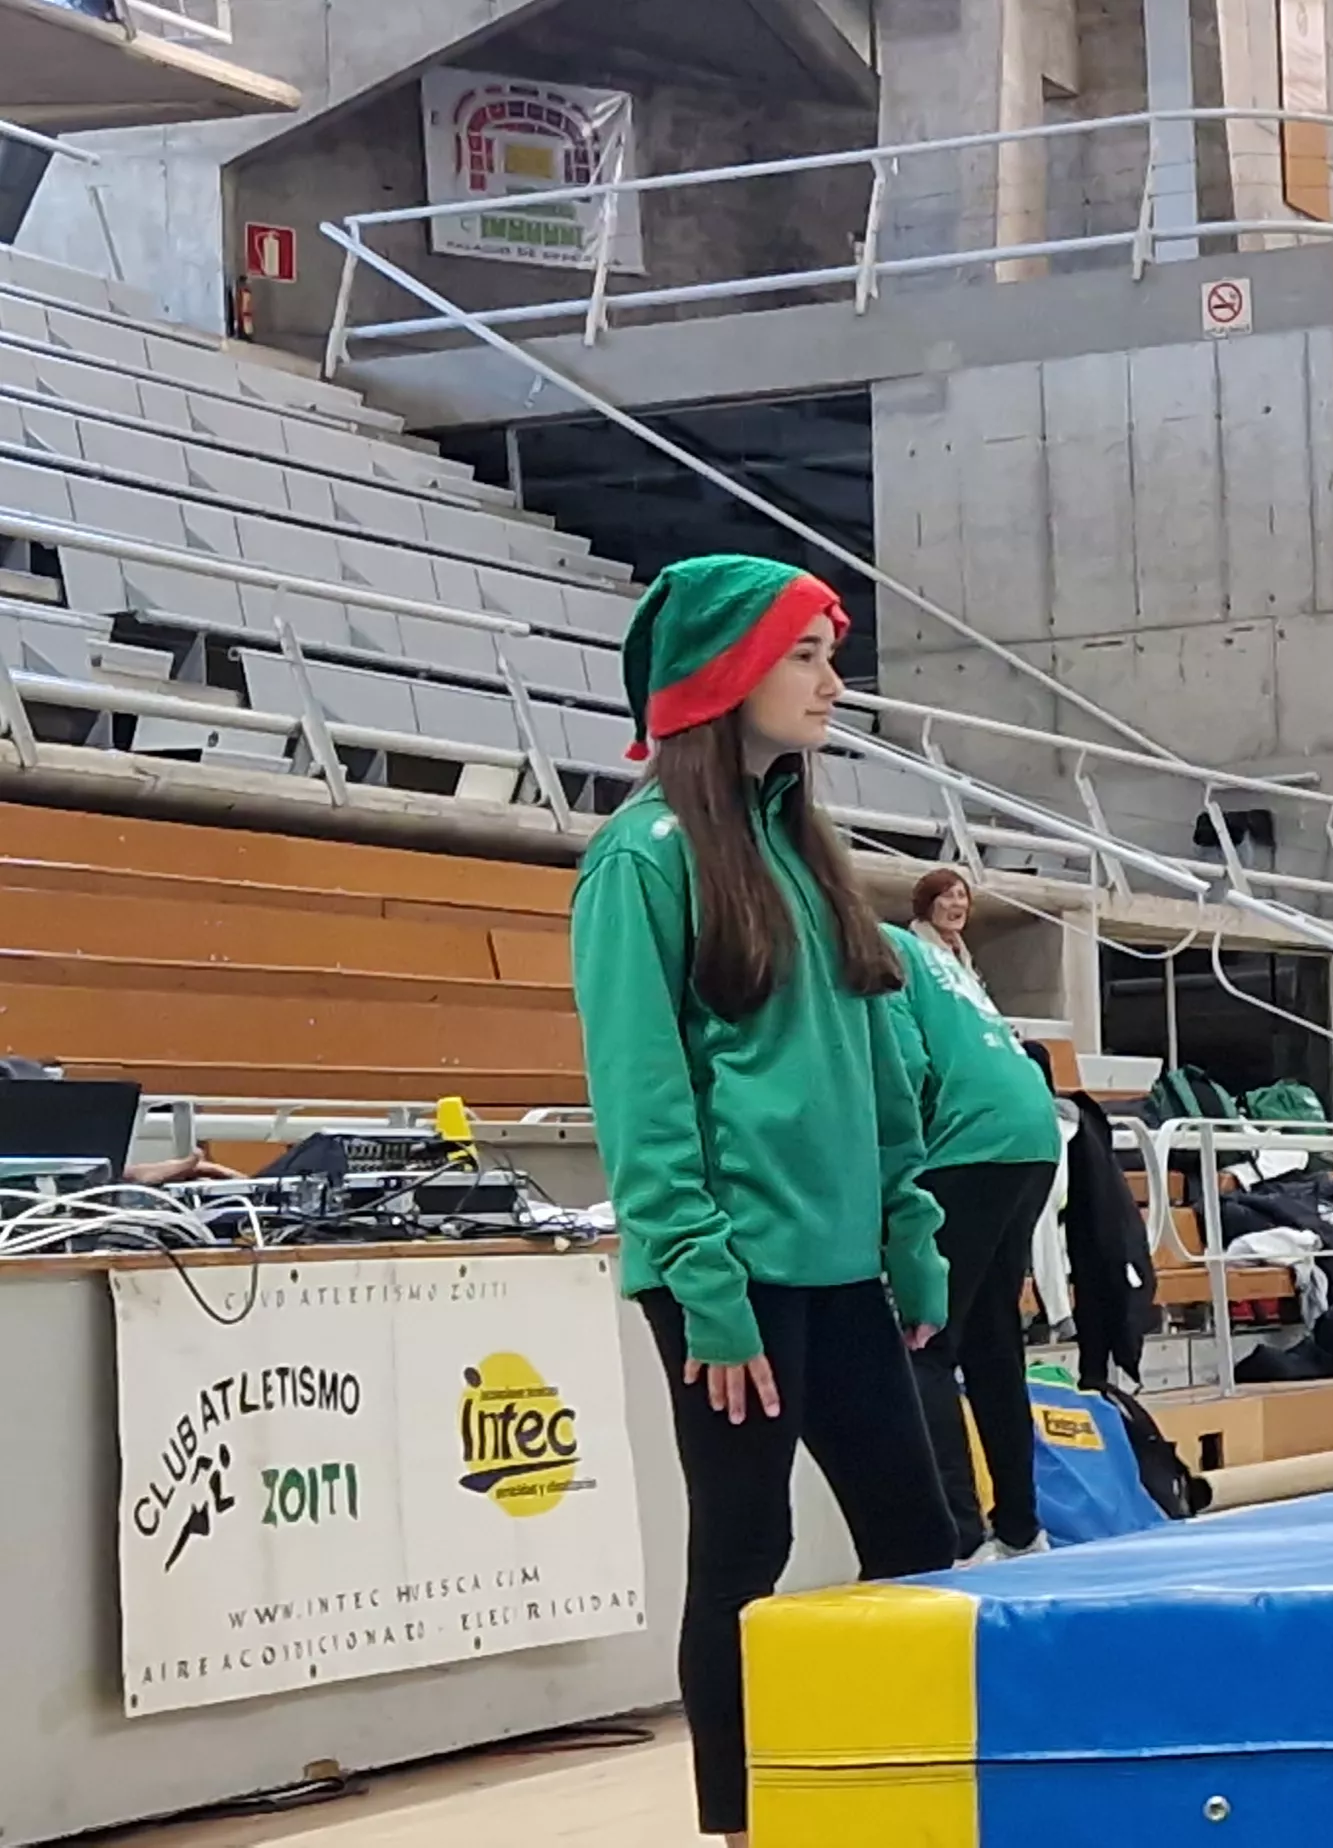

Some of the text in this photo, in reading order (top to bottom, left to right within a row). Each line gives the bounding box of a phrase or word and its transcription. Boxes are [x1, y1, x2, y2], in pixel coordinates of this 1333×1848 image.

[298, 1283, 439, 1307] ATLETISMO
[449, 1281, 508, 1301] ZOITI
[133, 1364, 361, 1536] CLUB ATLETISMO
[260, 1461, 360, 1528] ZOITI
[459, 1588, 639, 1632] ELECRICIDAD
